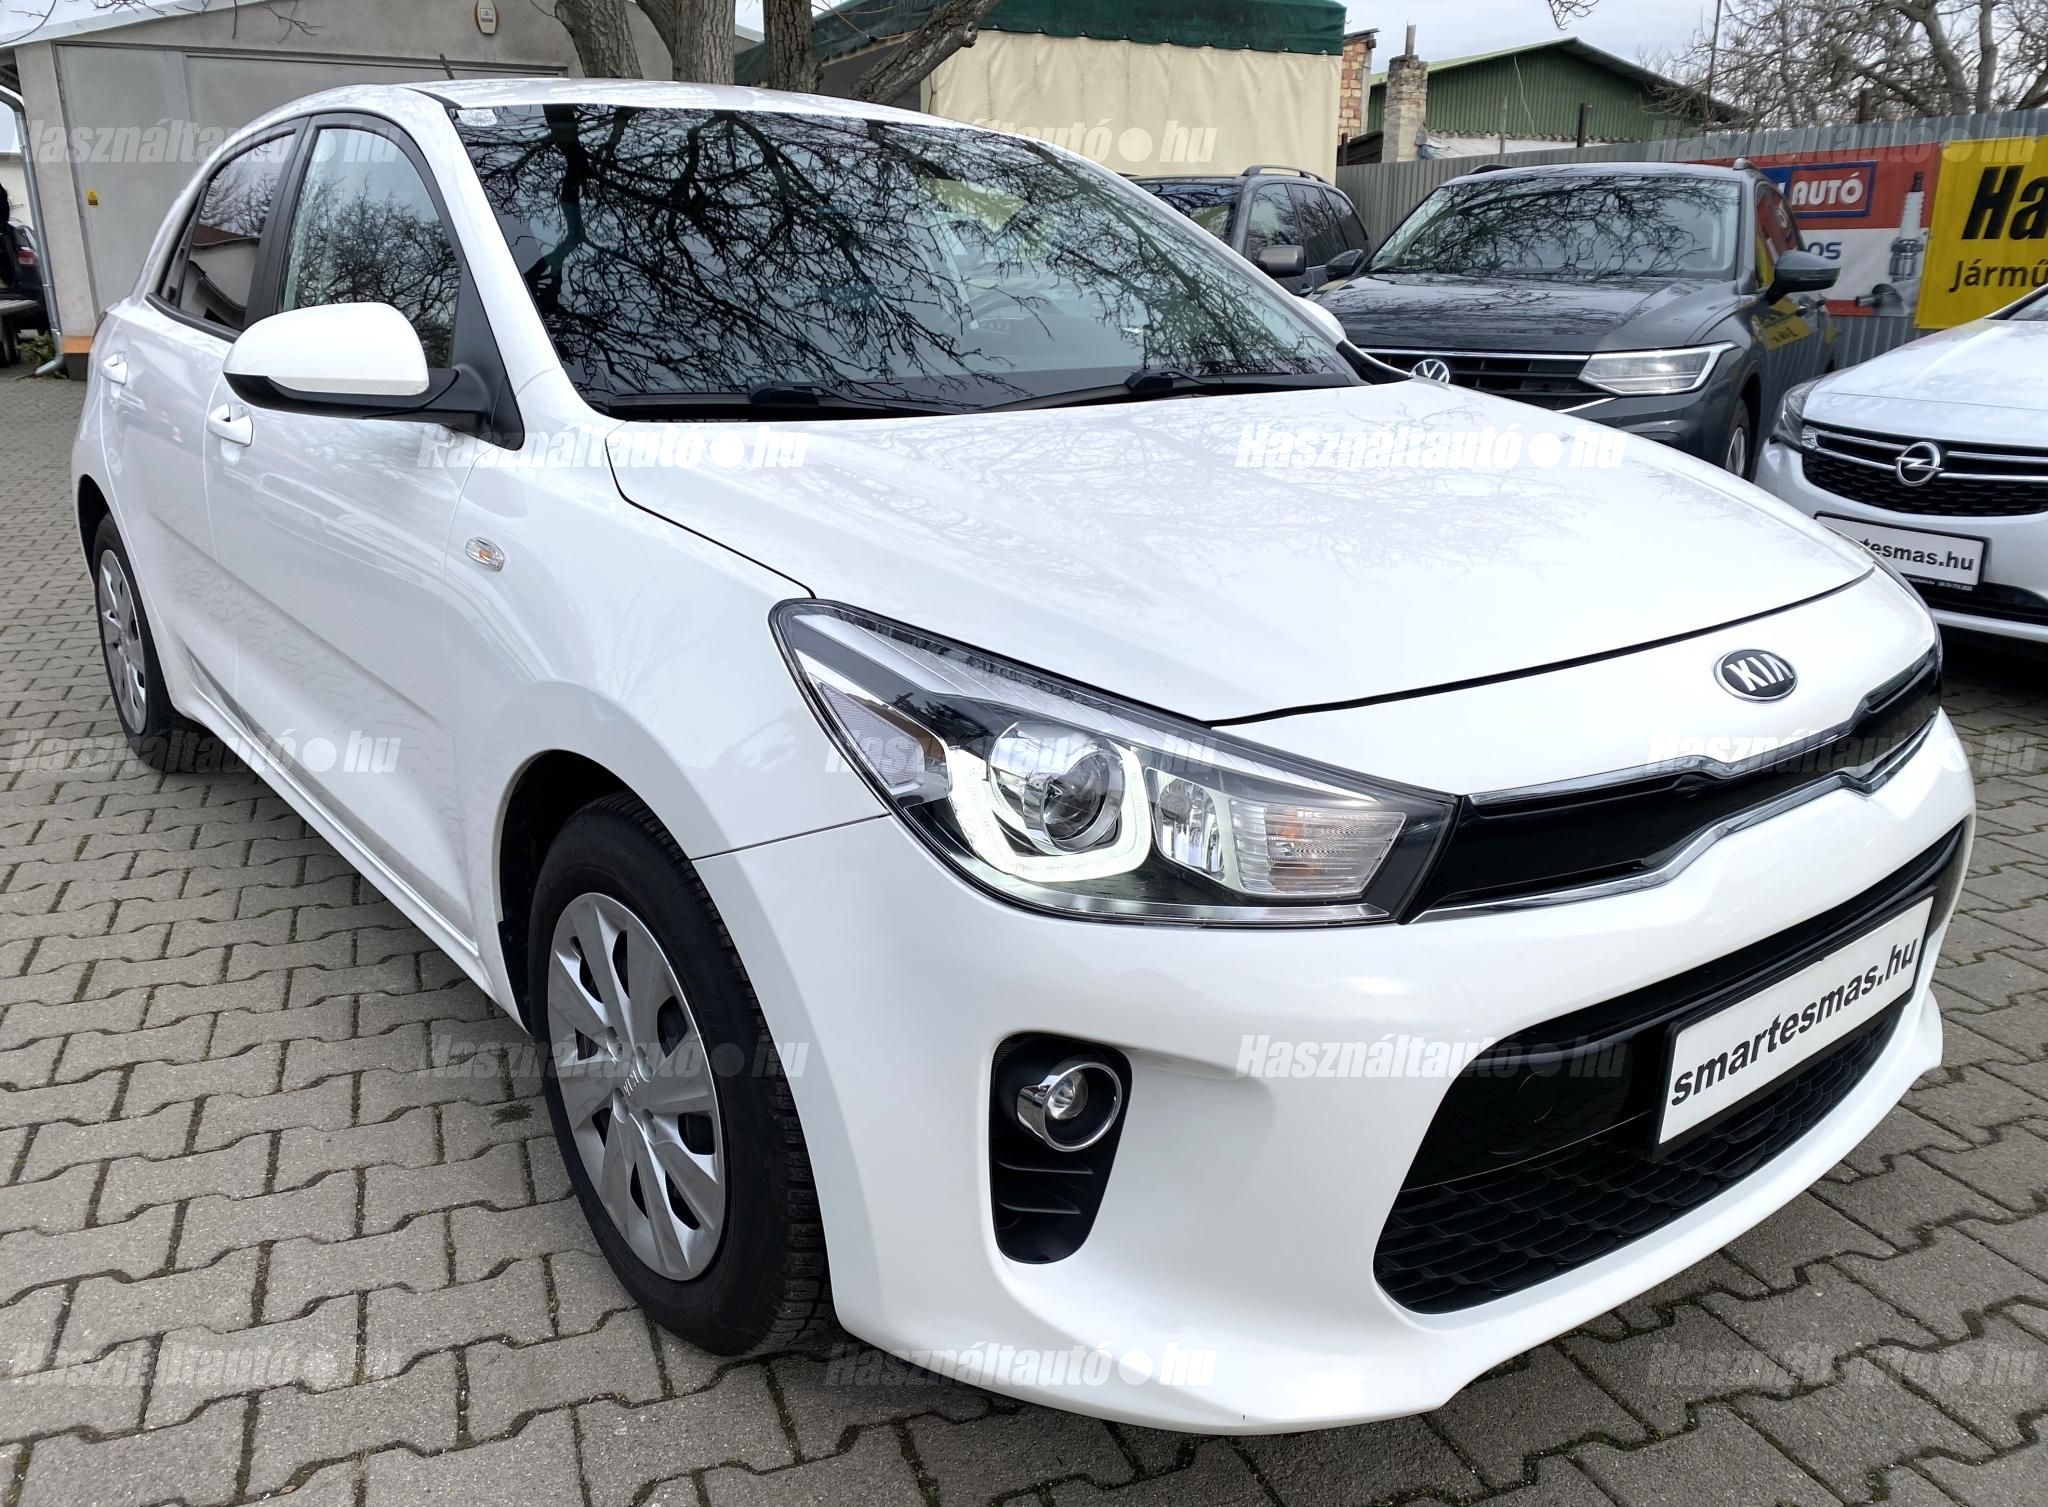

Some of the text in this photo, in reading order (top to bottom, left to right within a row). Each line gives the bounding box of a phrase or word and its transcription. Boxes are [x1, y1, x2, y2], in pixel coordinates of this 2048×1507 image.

[1792, 171, 1863, 205] AUTÓ
[1961, 165, 2048, 240] Ha
[1859, 538, 1974, 571] tesmas.hu
[1725, 653, 1794, 692] KIA
[1671, 938, 1918, 1106] smartesmas.hu
